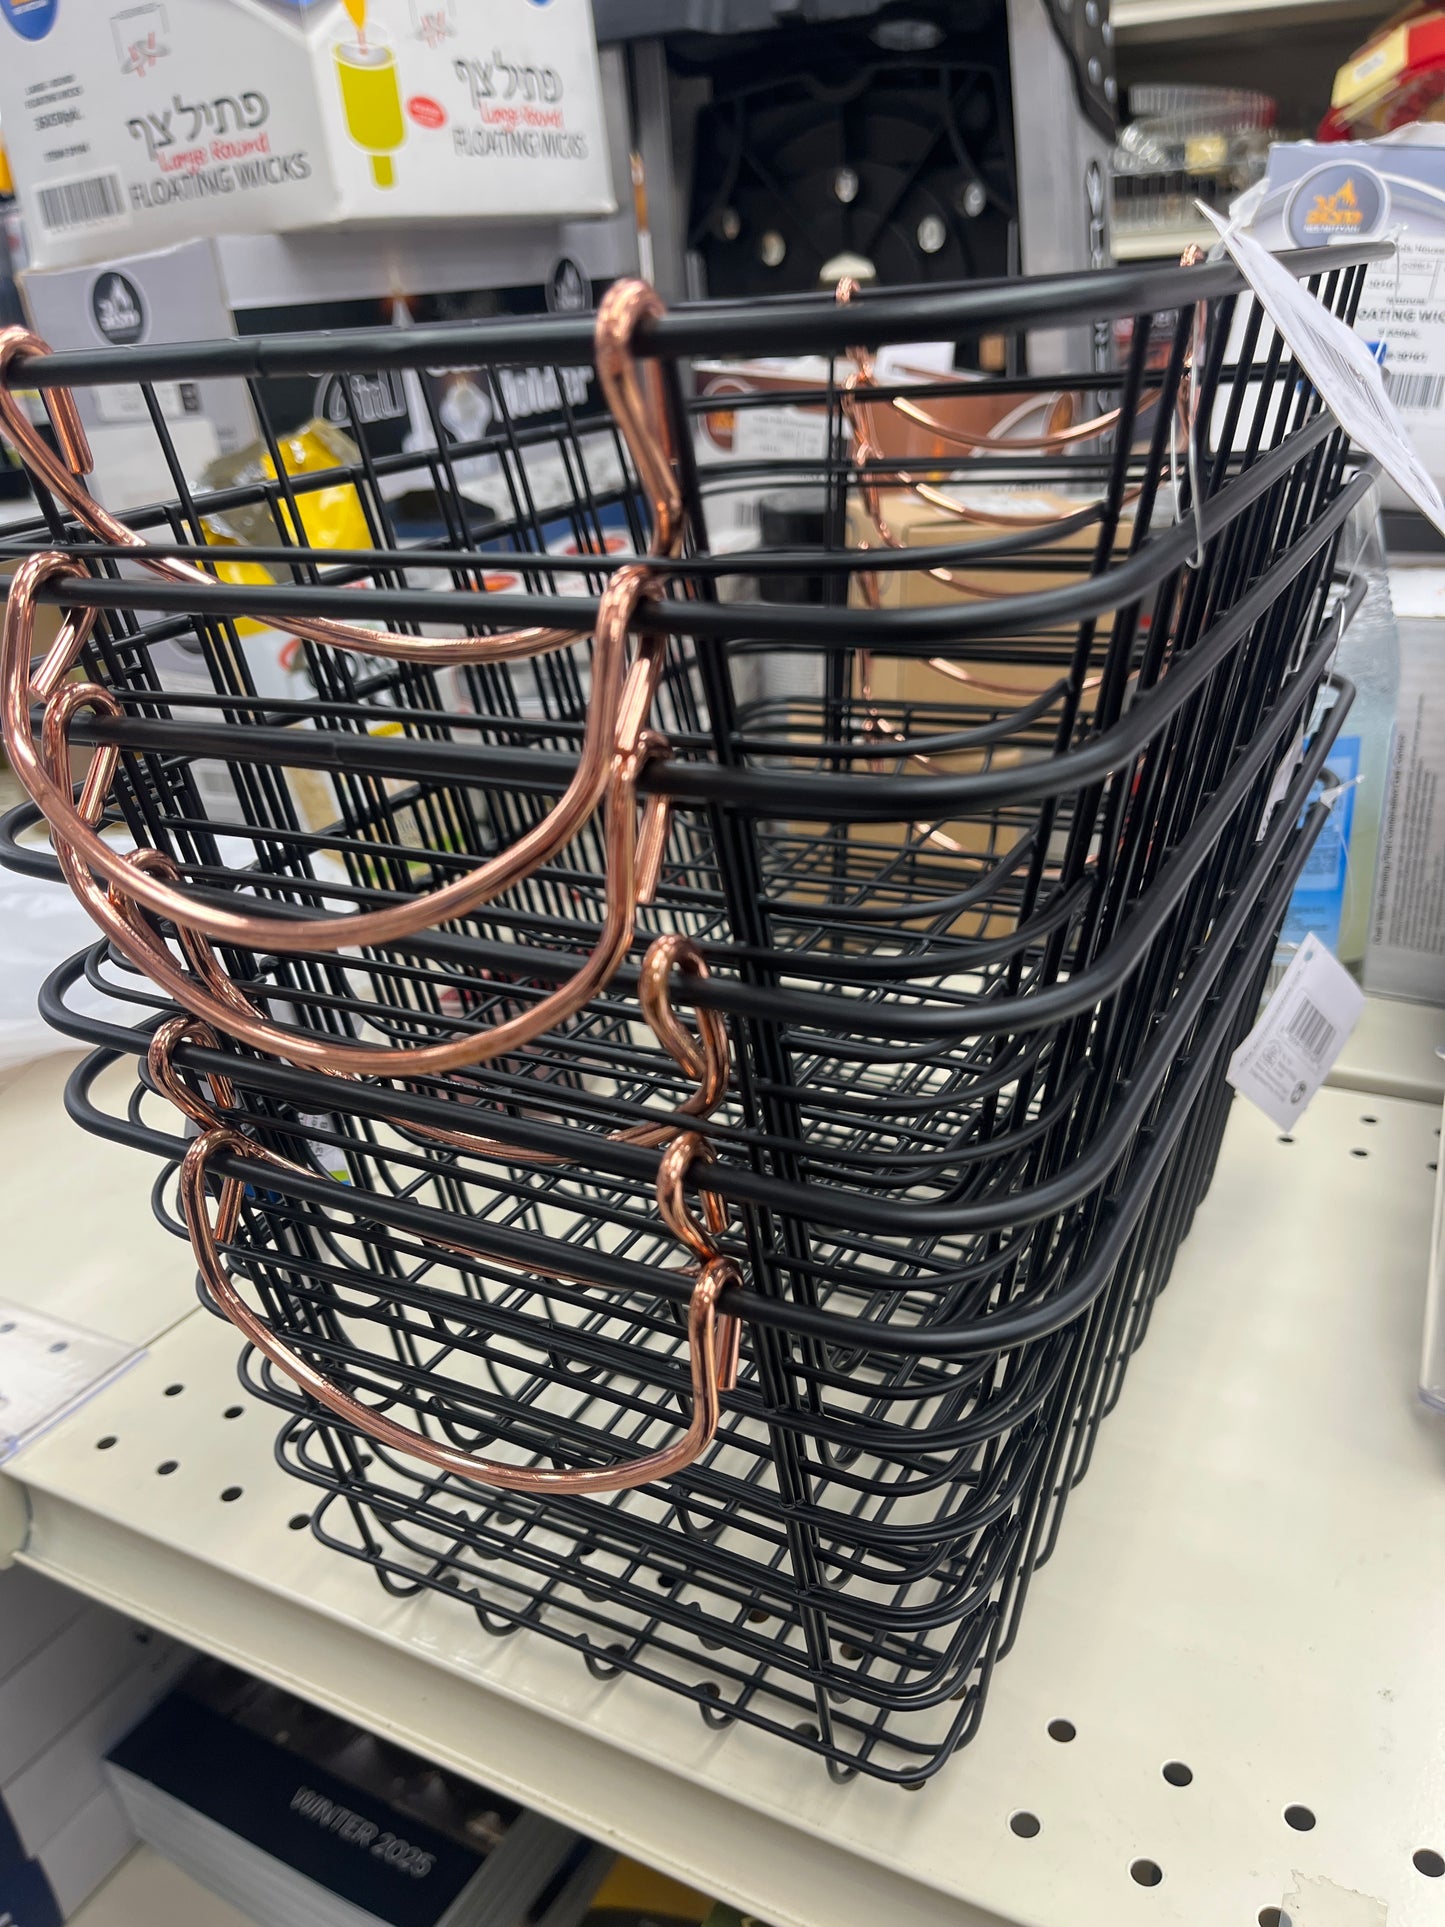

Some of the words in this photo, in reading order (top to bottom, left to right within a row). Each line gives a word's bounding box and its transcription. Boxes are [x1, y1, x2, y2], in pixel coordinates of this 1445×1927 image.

[209, 132, 271, 162] Round
[128, 166, 235, 211] FLOATING
[232, 151, 312, 192] WICKS
[1357, 307, 1417, 322] OATING
[289, 1785, 380, 1848] WINTER
